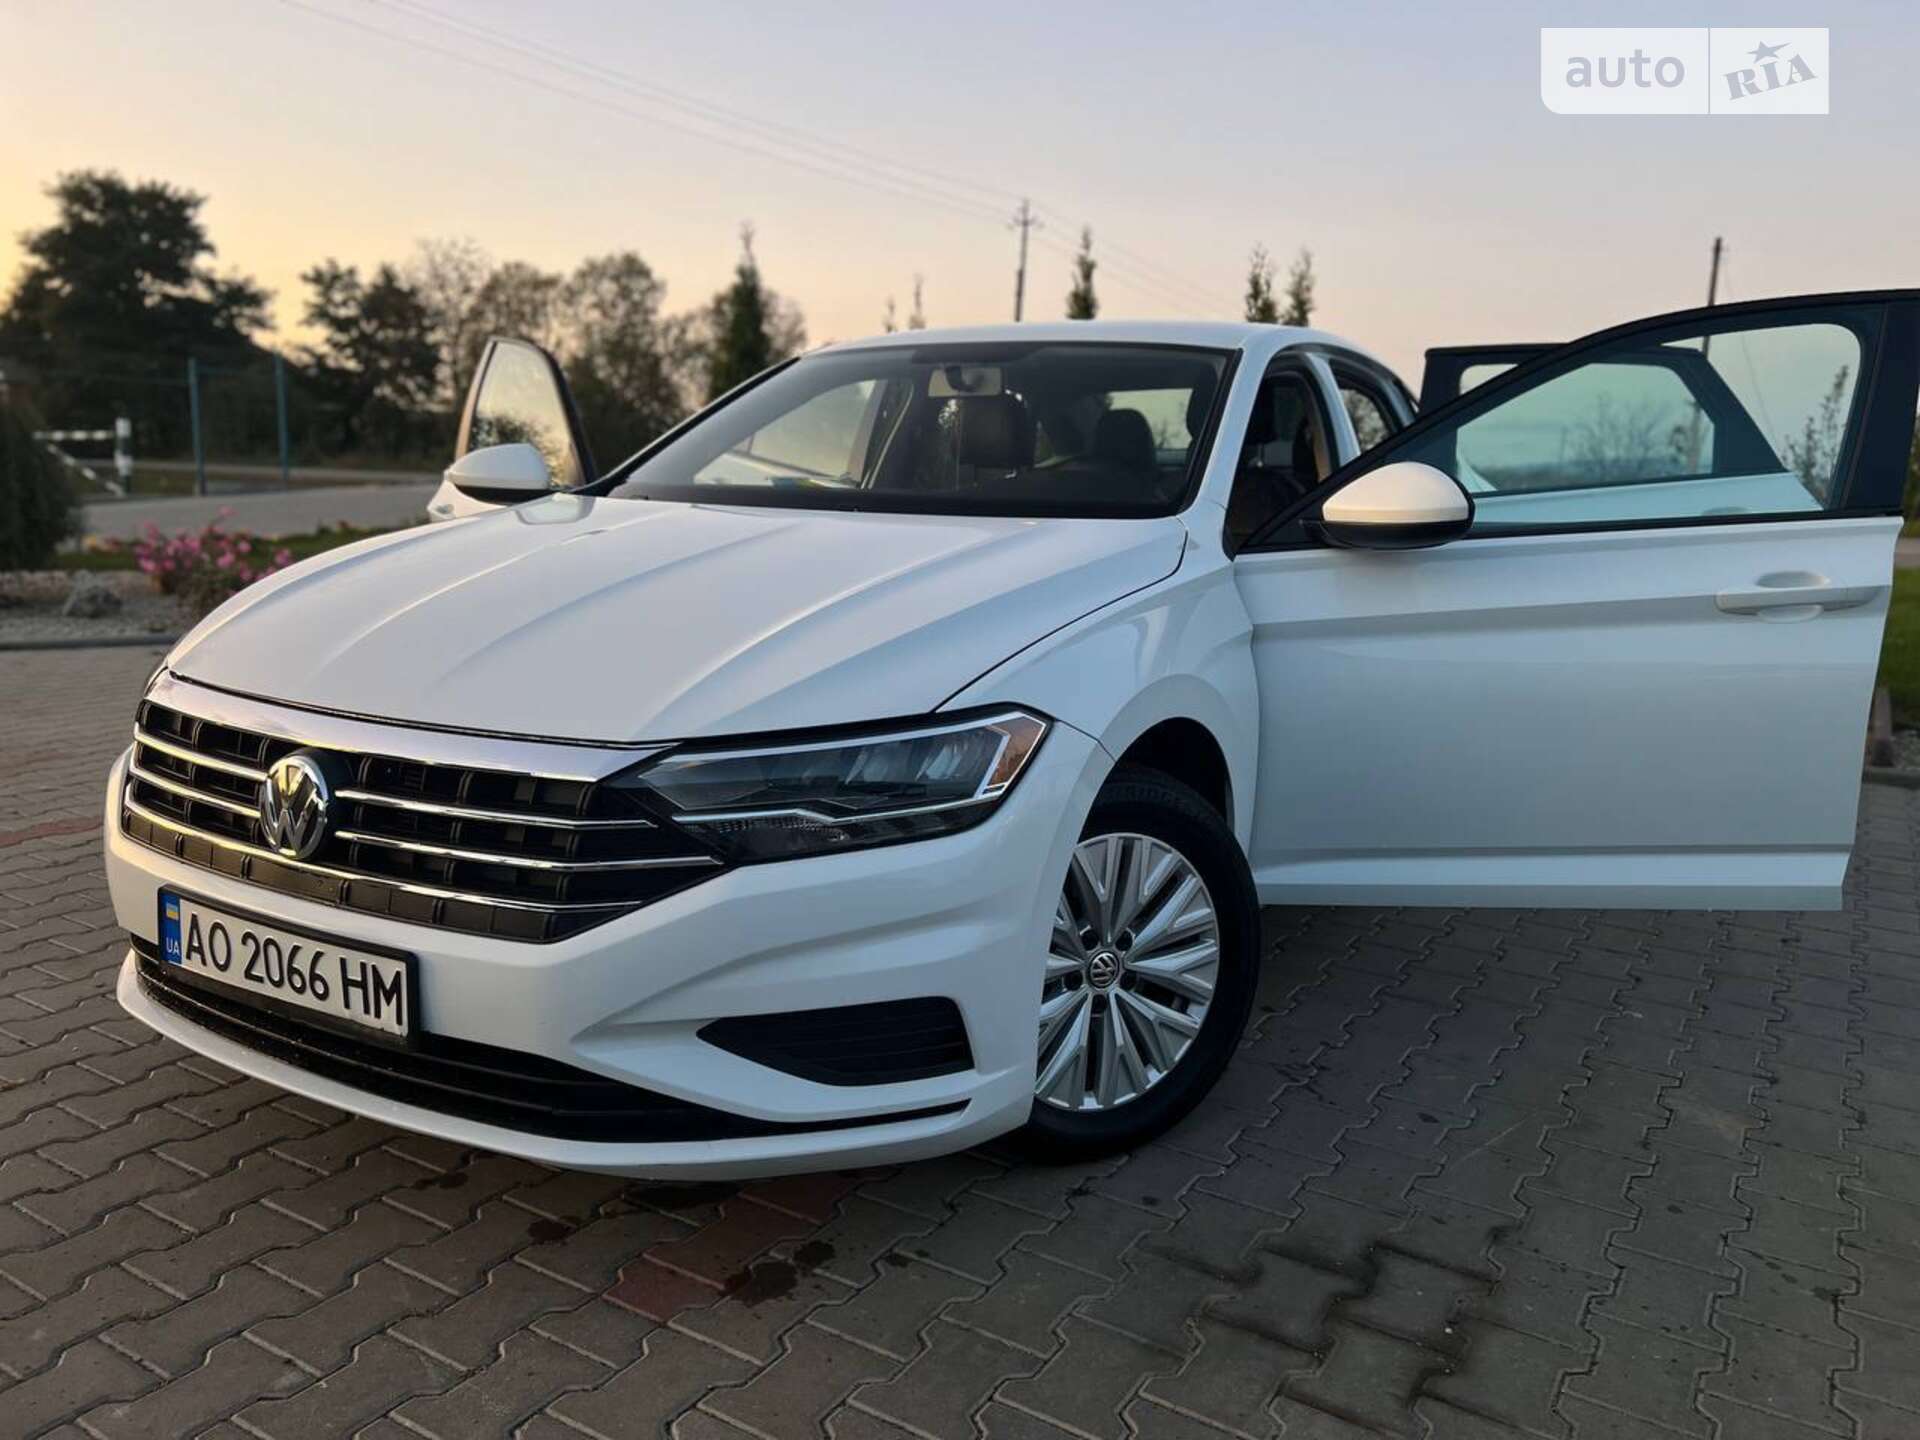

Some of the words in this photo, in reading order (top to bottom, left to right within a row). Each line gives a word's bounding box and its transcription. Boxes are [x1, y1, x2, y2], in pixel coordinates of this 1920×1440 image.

[165, 938, 181, 957] UA
[185, 912, 232, 972] AO
[240, 930, 330, 1001] 2066
[339, 956, 403, 1026] HM
